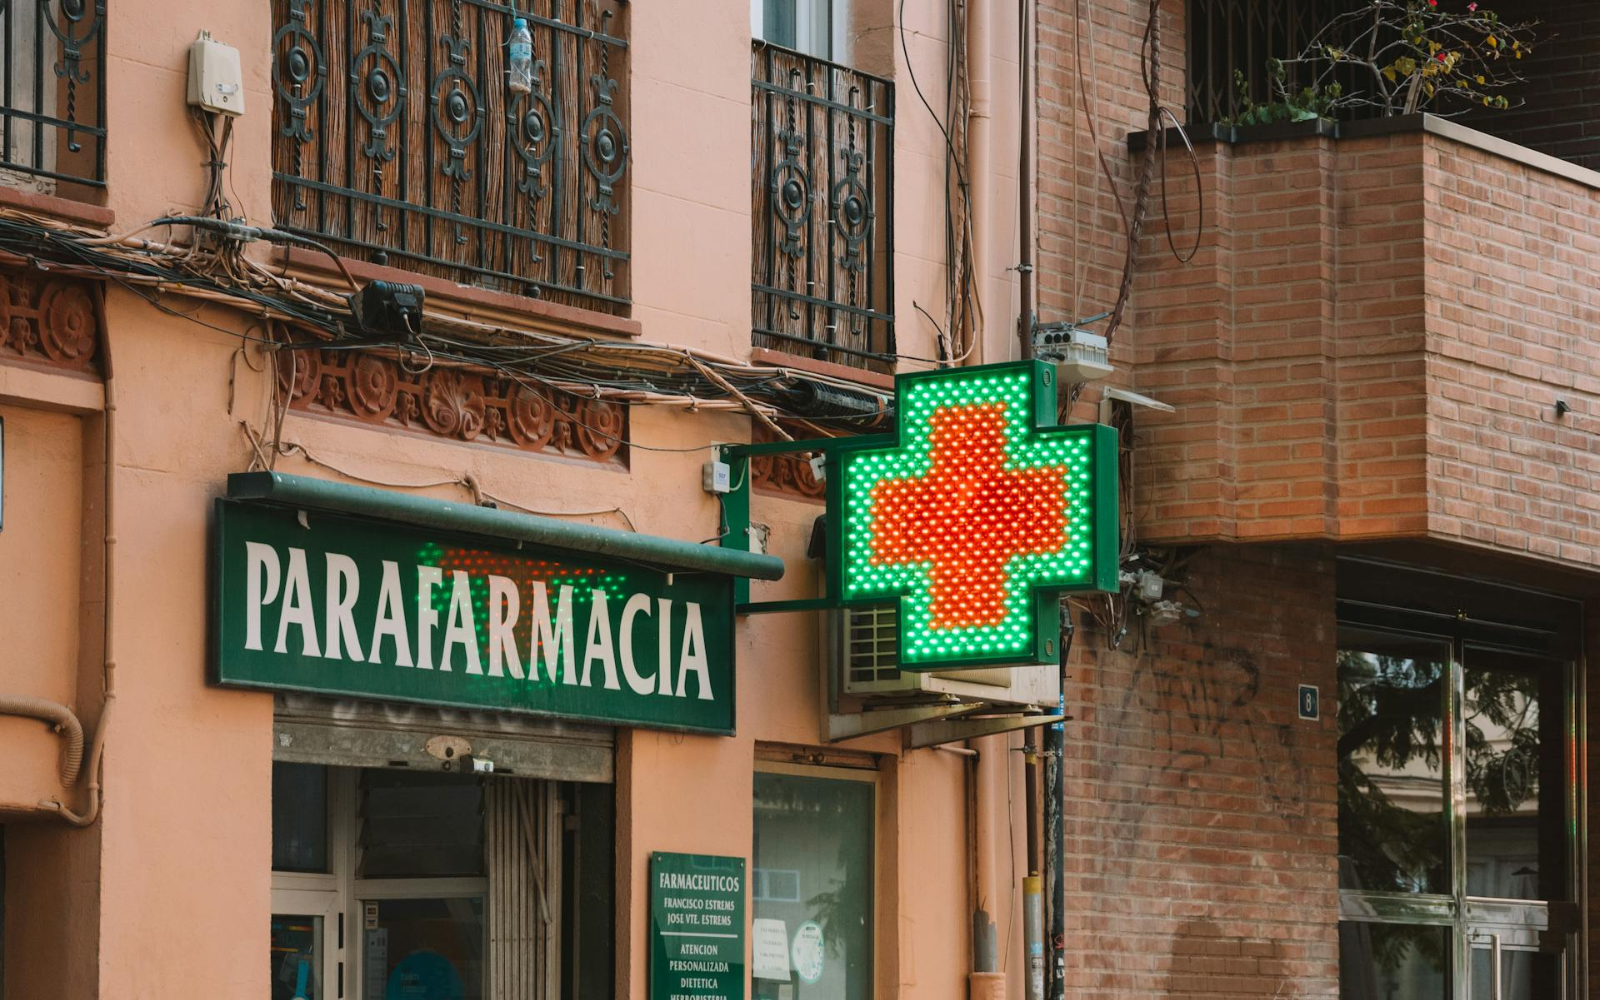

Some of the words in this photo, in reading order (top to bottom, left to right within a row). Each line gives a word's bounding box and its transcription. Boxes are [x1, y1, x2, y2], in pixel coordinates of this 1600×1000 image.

[245, 541, 715, 700] PARAFARMACIA
[1306, 692, 1312, 712] 8
[660, 872, 739, 892] FARMACEUTICOS
[664, 897, 703, 910] FRANCISCO
[705, 899, 735, 911] ESTREMS
[667, 913, 684, 925] JOSE
[686, 914, 700, 925] VTE.
[702, 915, 731, 926] ESTREMS
[680, 944, 718, 955] ATENCION
[669, 960, 729, 972] PERSONALIZADA
[680, 977, 718, 989] DIETETICA
